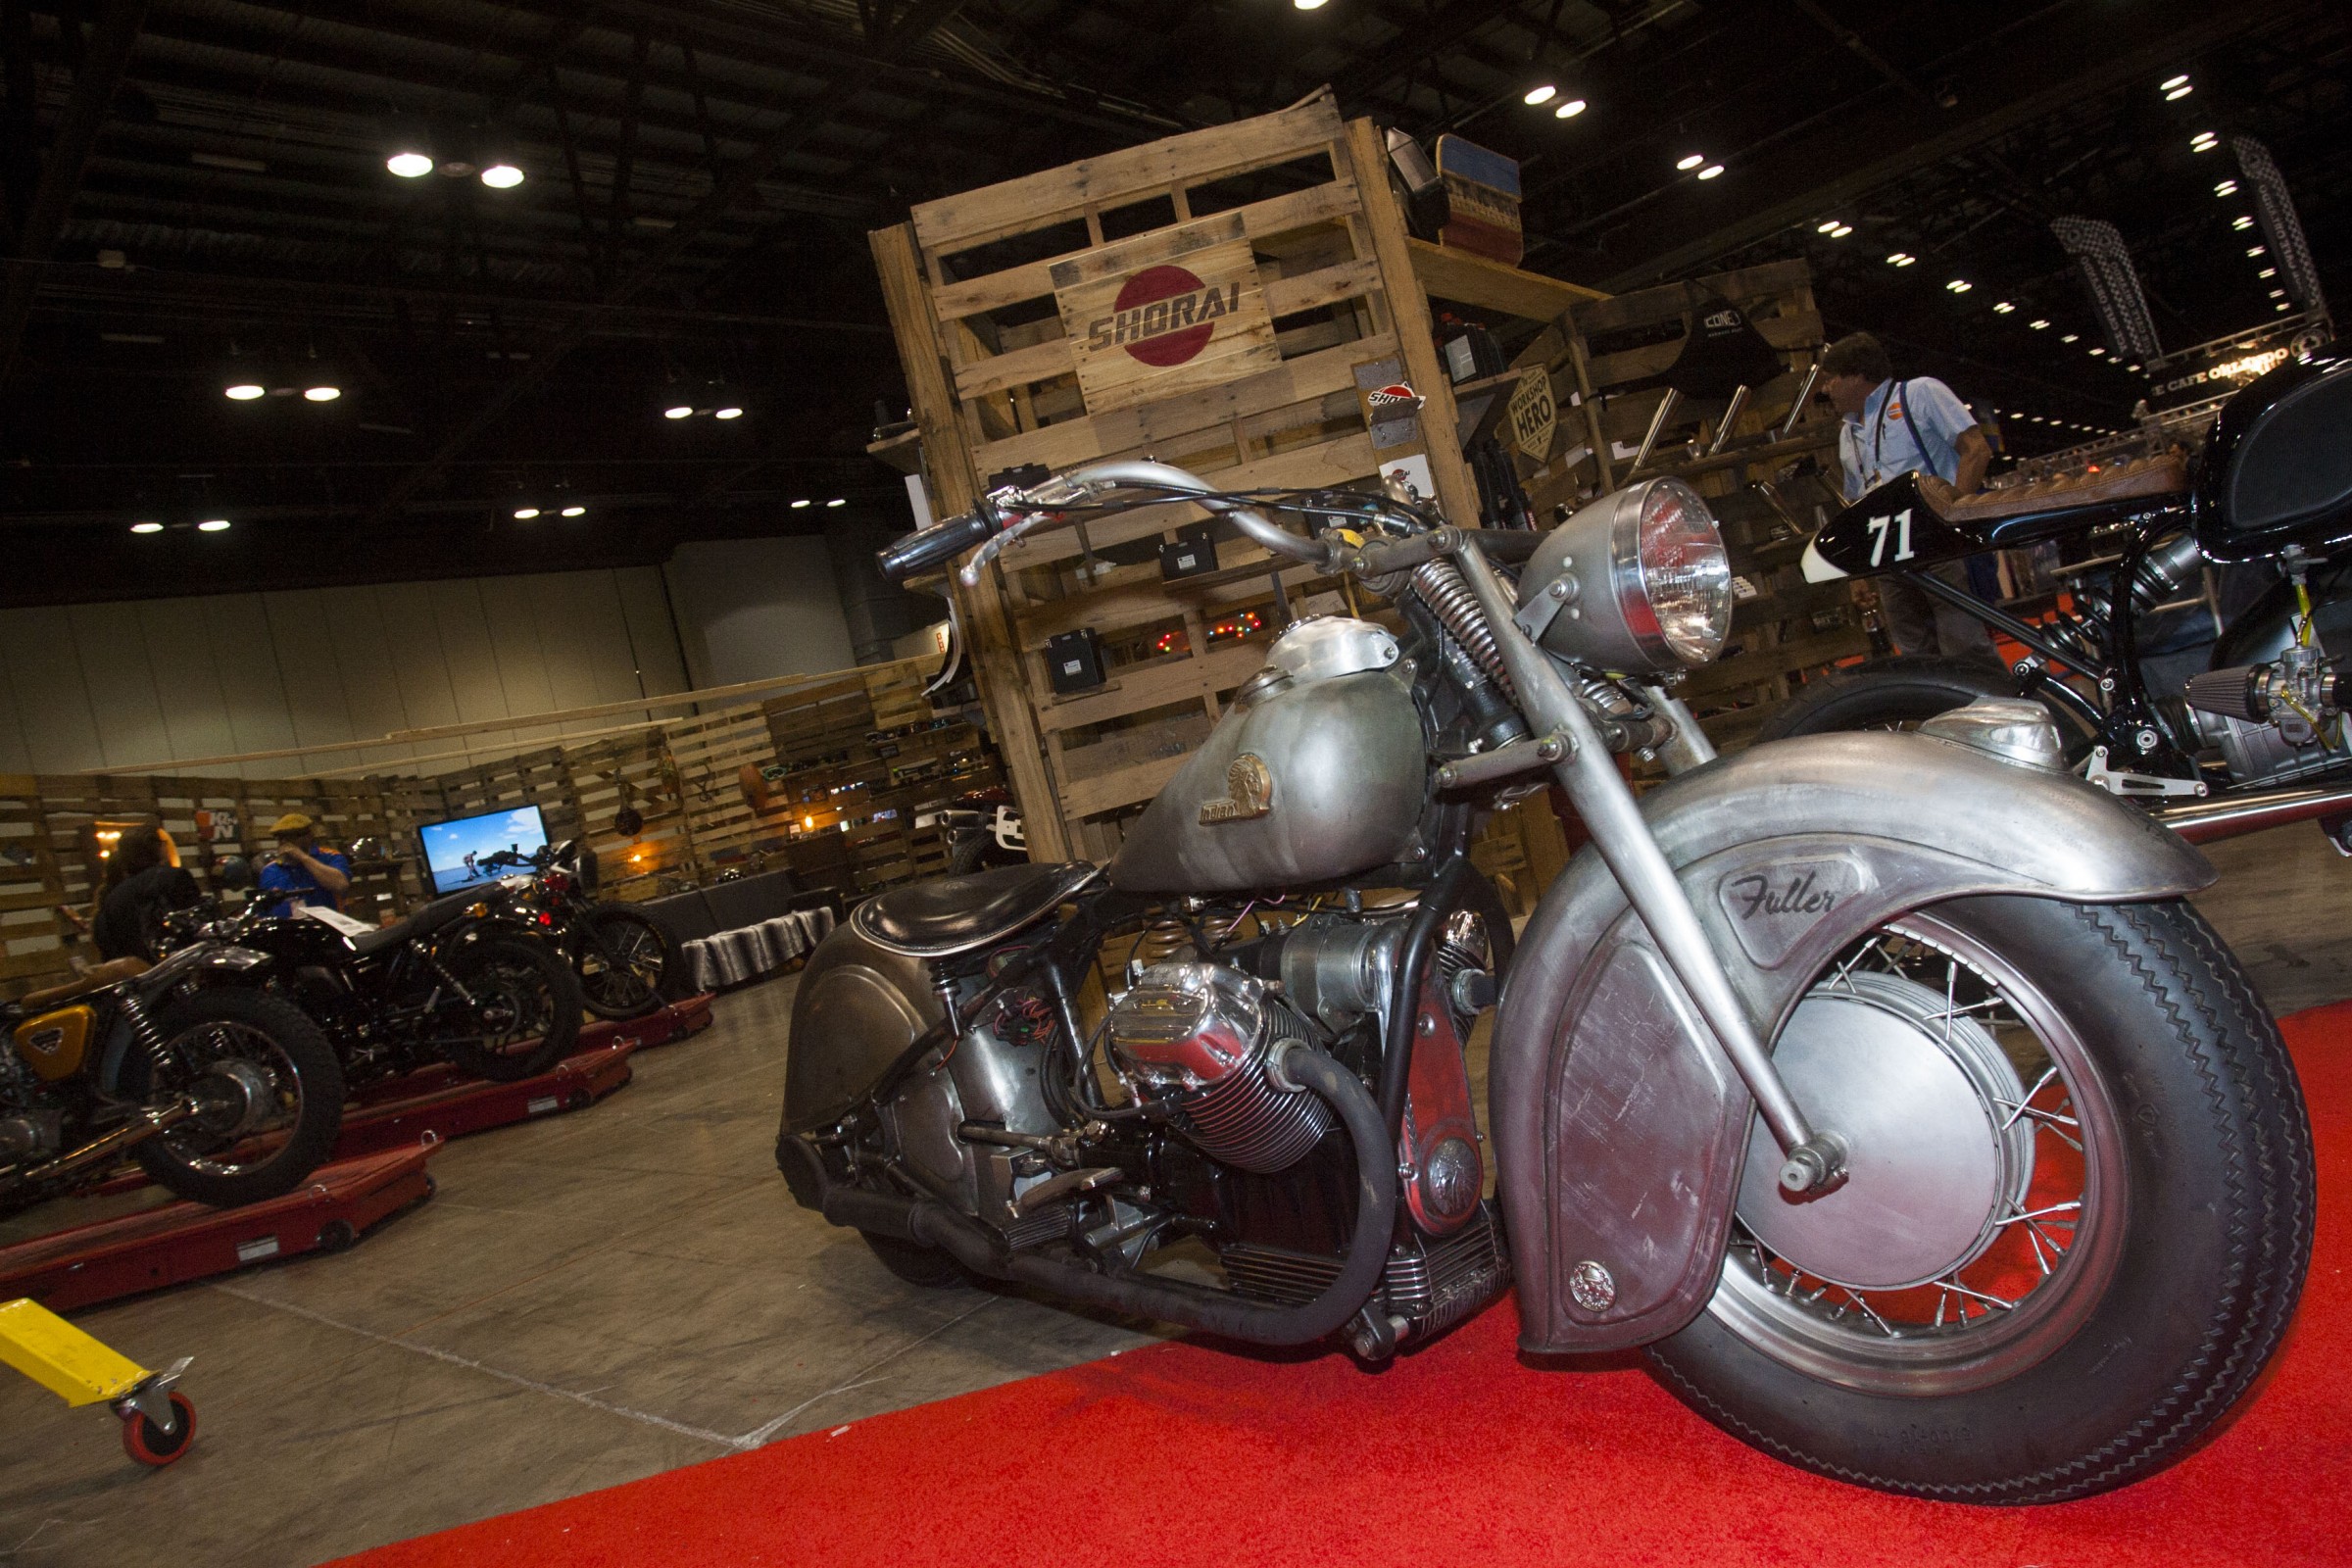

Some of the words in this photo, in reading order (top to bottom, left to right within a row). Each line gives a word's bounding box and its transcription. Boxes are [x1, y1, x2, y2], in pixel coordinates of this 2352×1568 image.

[1088, 281, 1240, 352] SHORAI
[1510, 375, 1546, 414] WORKSHOP
[2168, 371, 2207, 392] CAFE
[1516, 394, 1551, 441] HERO
[1867, 509, 1914, 567] 71
[1732, 870, 1836, 920] Fuller
